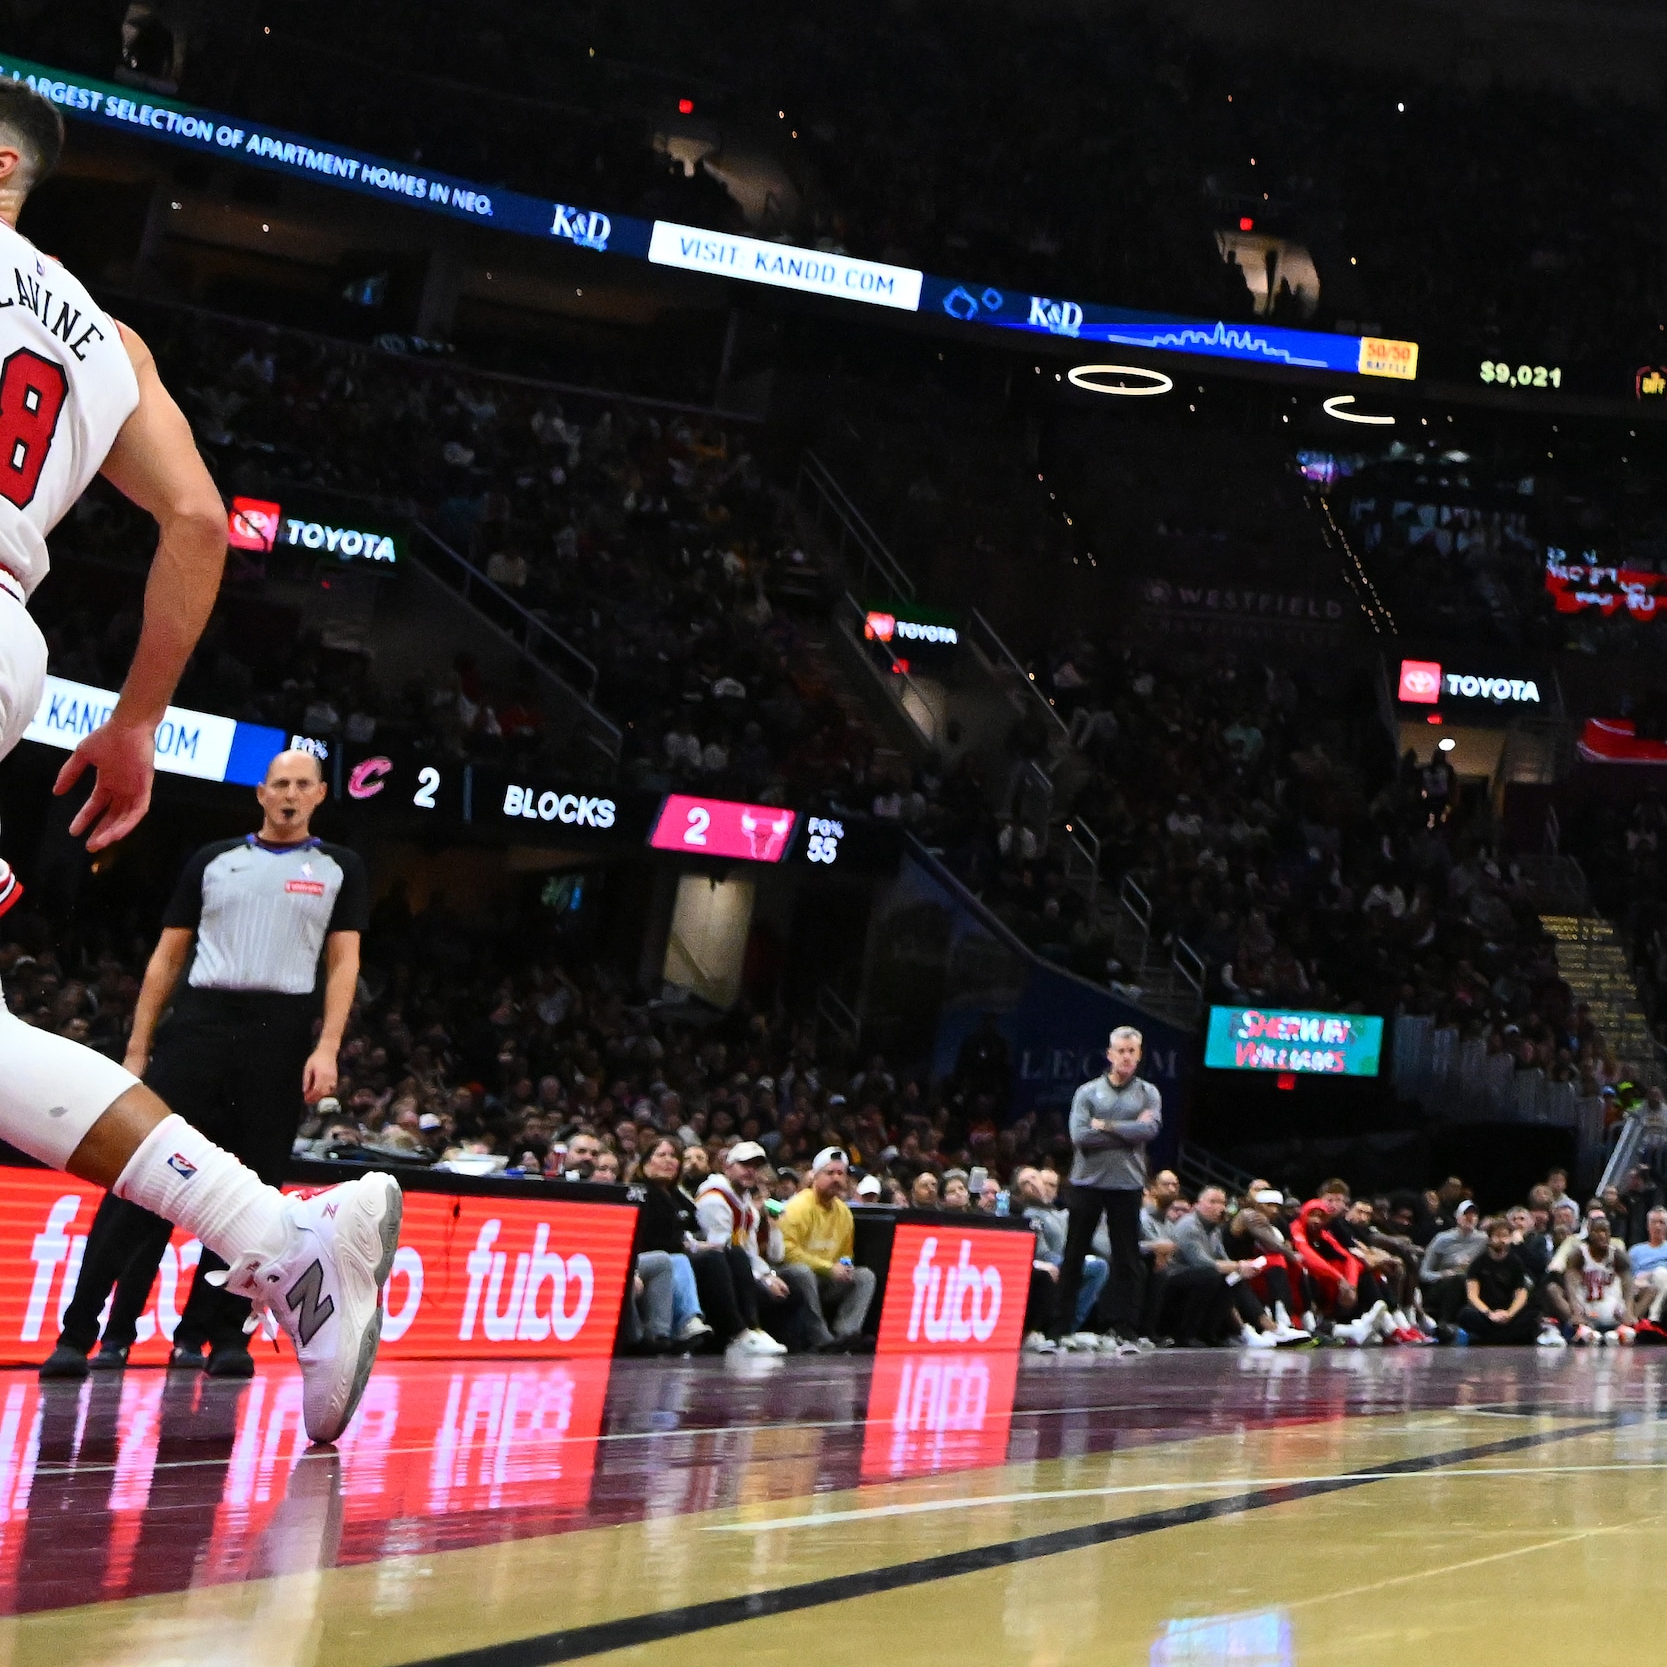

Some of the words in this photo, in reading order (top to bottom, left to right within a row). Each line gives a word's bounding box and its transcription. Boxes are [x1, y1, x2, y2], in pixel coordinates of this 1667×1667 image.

[104, 95, 214, 142] SELECTION
[215, 125, 246, 150] OF
[246, 133, 360, 181] APARTMENT
[361, 163, 427, 200] HOMES
[428, 180, 450, 205] IN
[550, 202, 612, 244] K&D
[678, 235, 746, 270] VISIT:
[753, 248, 897, 298] KANDD.COM
[1028, 295, 1084, 334] K&D
[1479, 359, 1562, 390] $9,021
[286, 519, 398, 564] TOYOTA
[895, 620, 958, 645] TOYOTA
[1447, 673, 1540, 703] TOYOTA
[413, 765, 442, 810] 2
[503, 783, 617, 830] BLOCKS
[683, 806, 711, 846] 2
[807, 817, 845, 839] FG%
[806, 836, 838, 865] 55
[1020, 1049, 1178, 1081] LECM
[459, 1217, 596, 1343] fubo
[907, 1235, 1003, 1346] fubo
